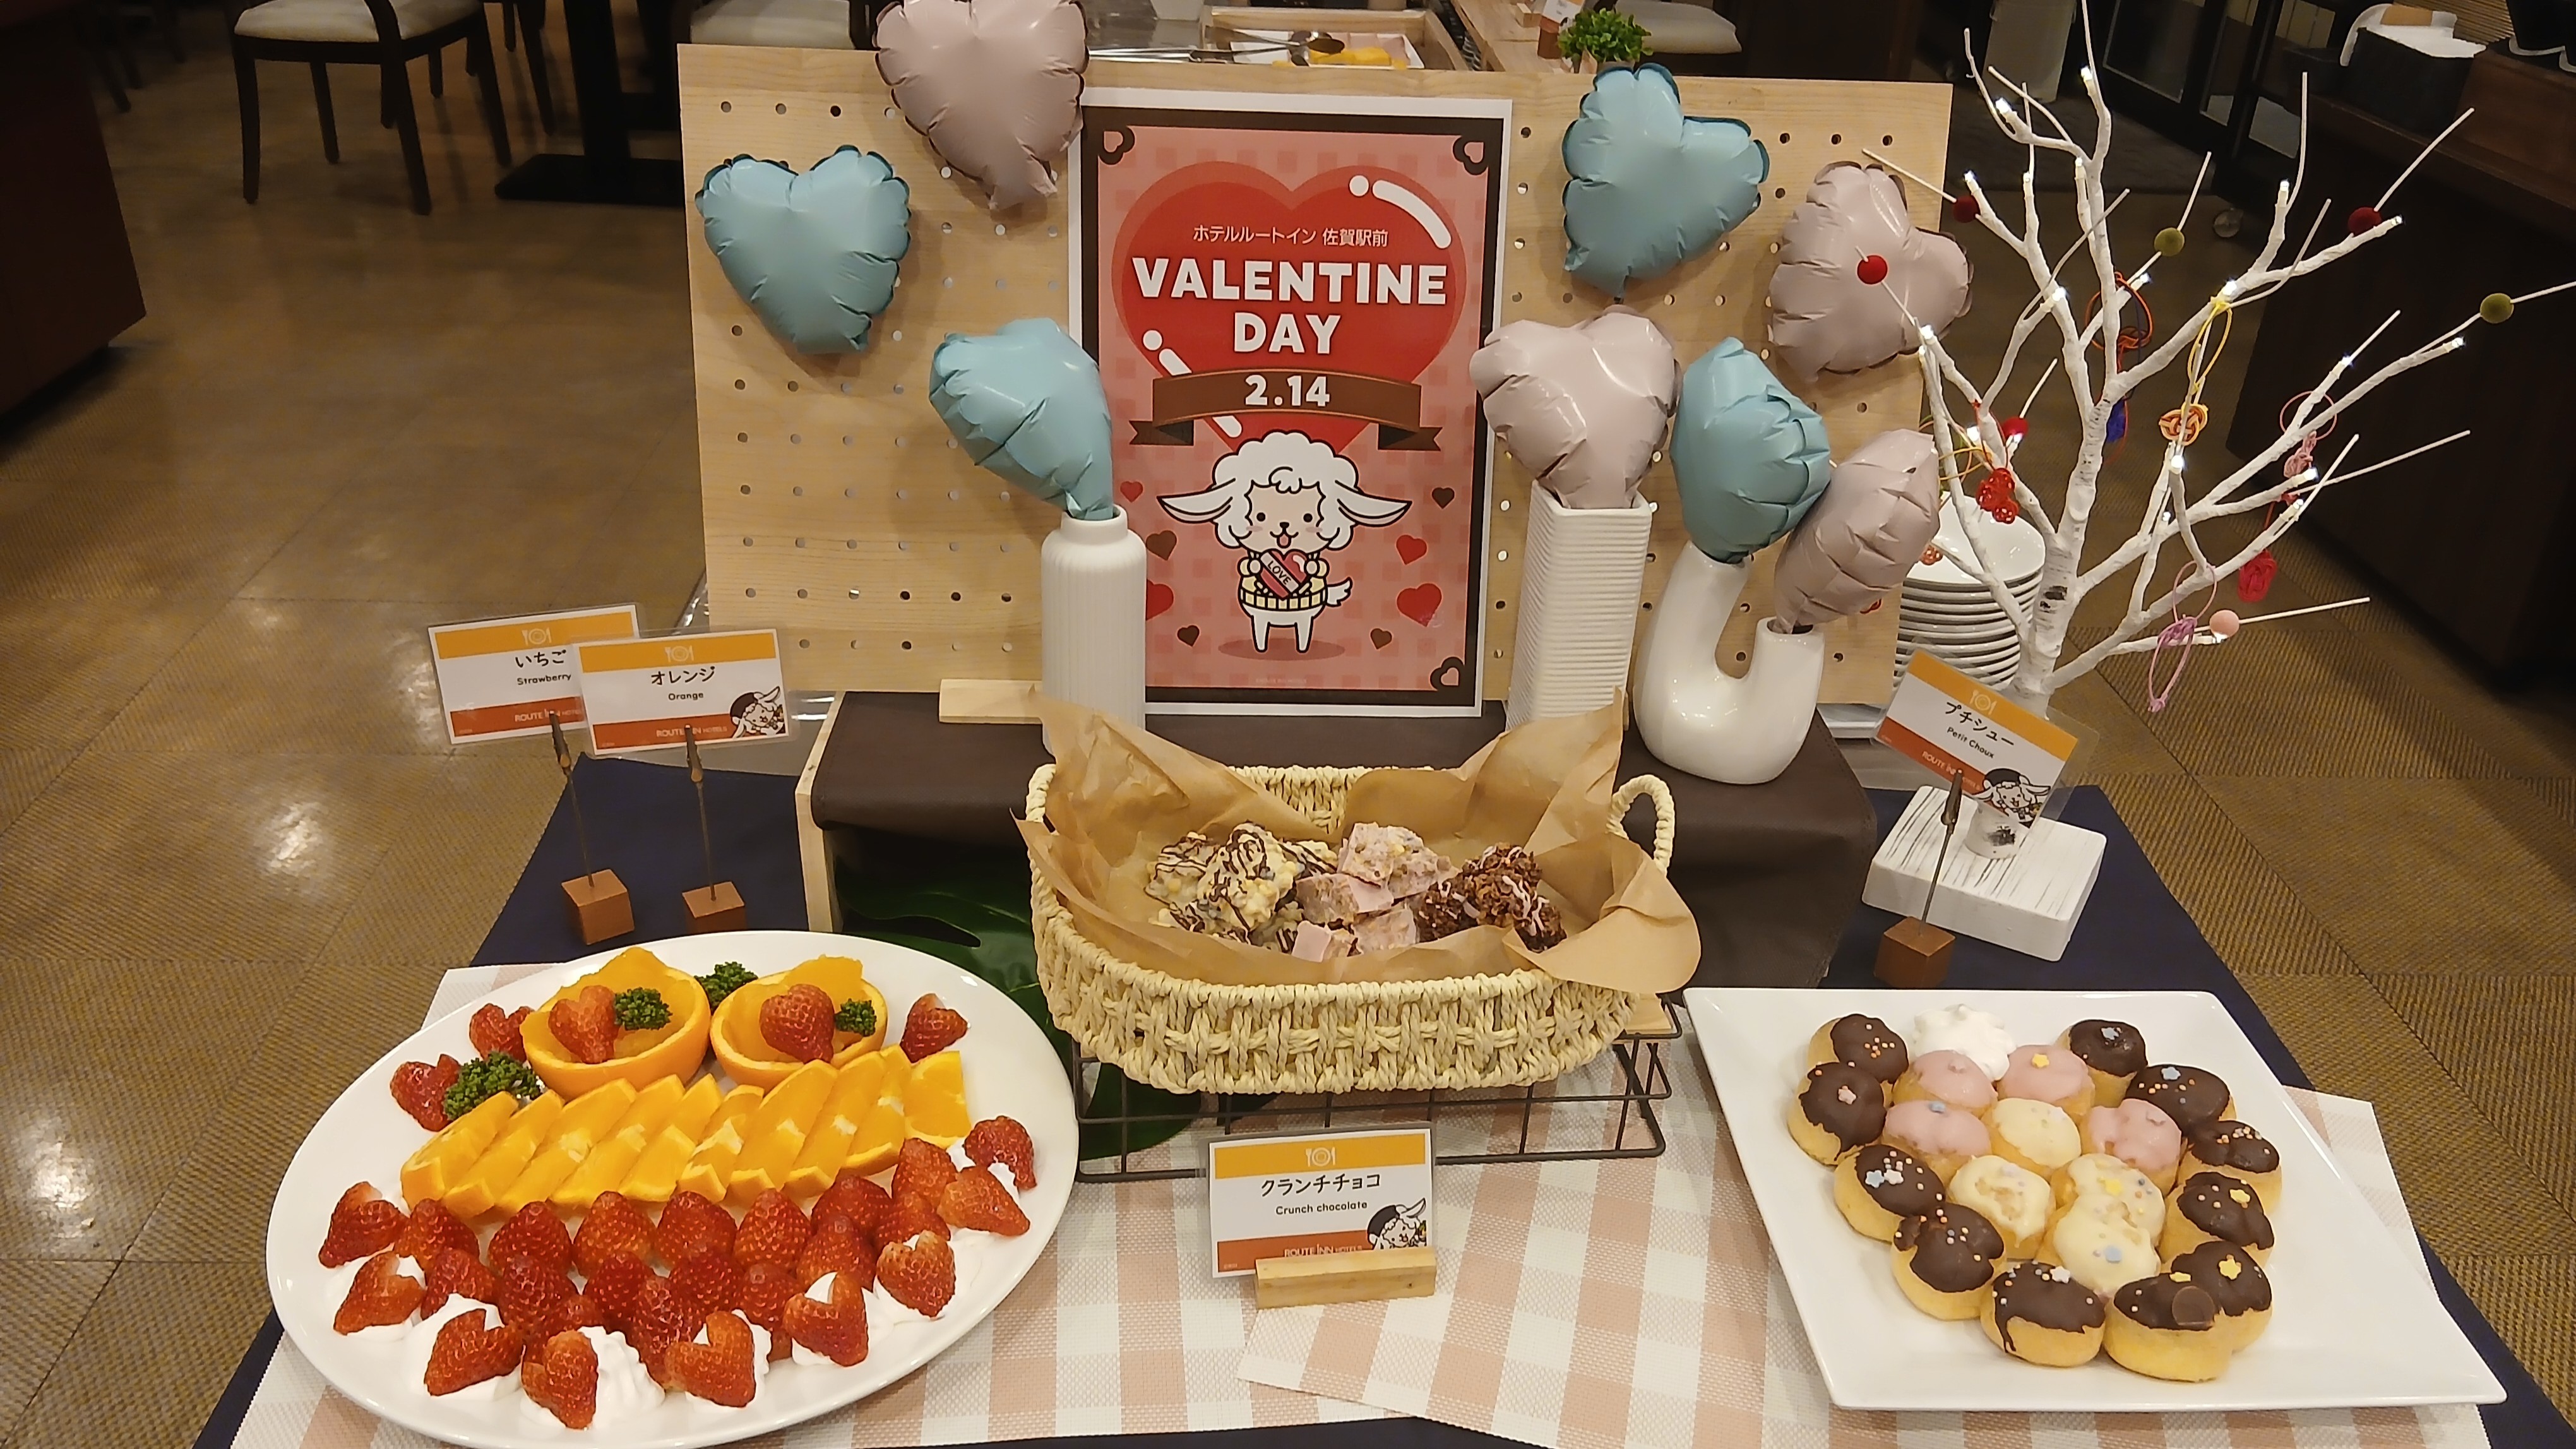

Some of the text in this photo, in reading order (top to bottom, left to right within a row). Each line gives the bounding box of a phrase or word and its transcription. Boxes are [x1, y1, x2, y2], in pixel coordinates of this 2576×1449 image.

[1192, 224, 1389, 247] ホテルルートイン 佐賀駅前
[1131, 257, 1447, 306] VALENTINE
[1233, 312, 1342, 355] DAY
[1244, 374, 1331, 408] 2.14
[1267, 560, 1292, 585] LOVE
[515, 649, 567, 668] いちご
[517, 674, 571, 686] Strawberry
[651, 665, 715, 686] オレンジ
[668, 693, 704, 701] Orange
[515, 712, 544, 722] ROUTE
[1945, 701, 2014, 746] プチシュー
[1947, 727, 1995, 759] Petit Choux
[1922, 751, 1945, 769] ROUTE
[1261, 1173, 1380, 1197] クランチチョコ
[1275, 1201, 1368, 1215] Crunch chocolate
[1284, 1247, 1315, 1257] ROUTE
